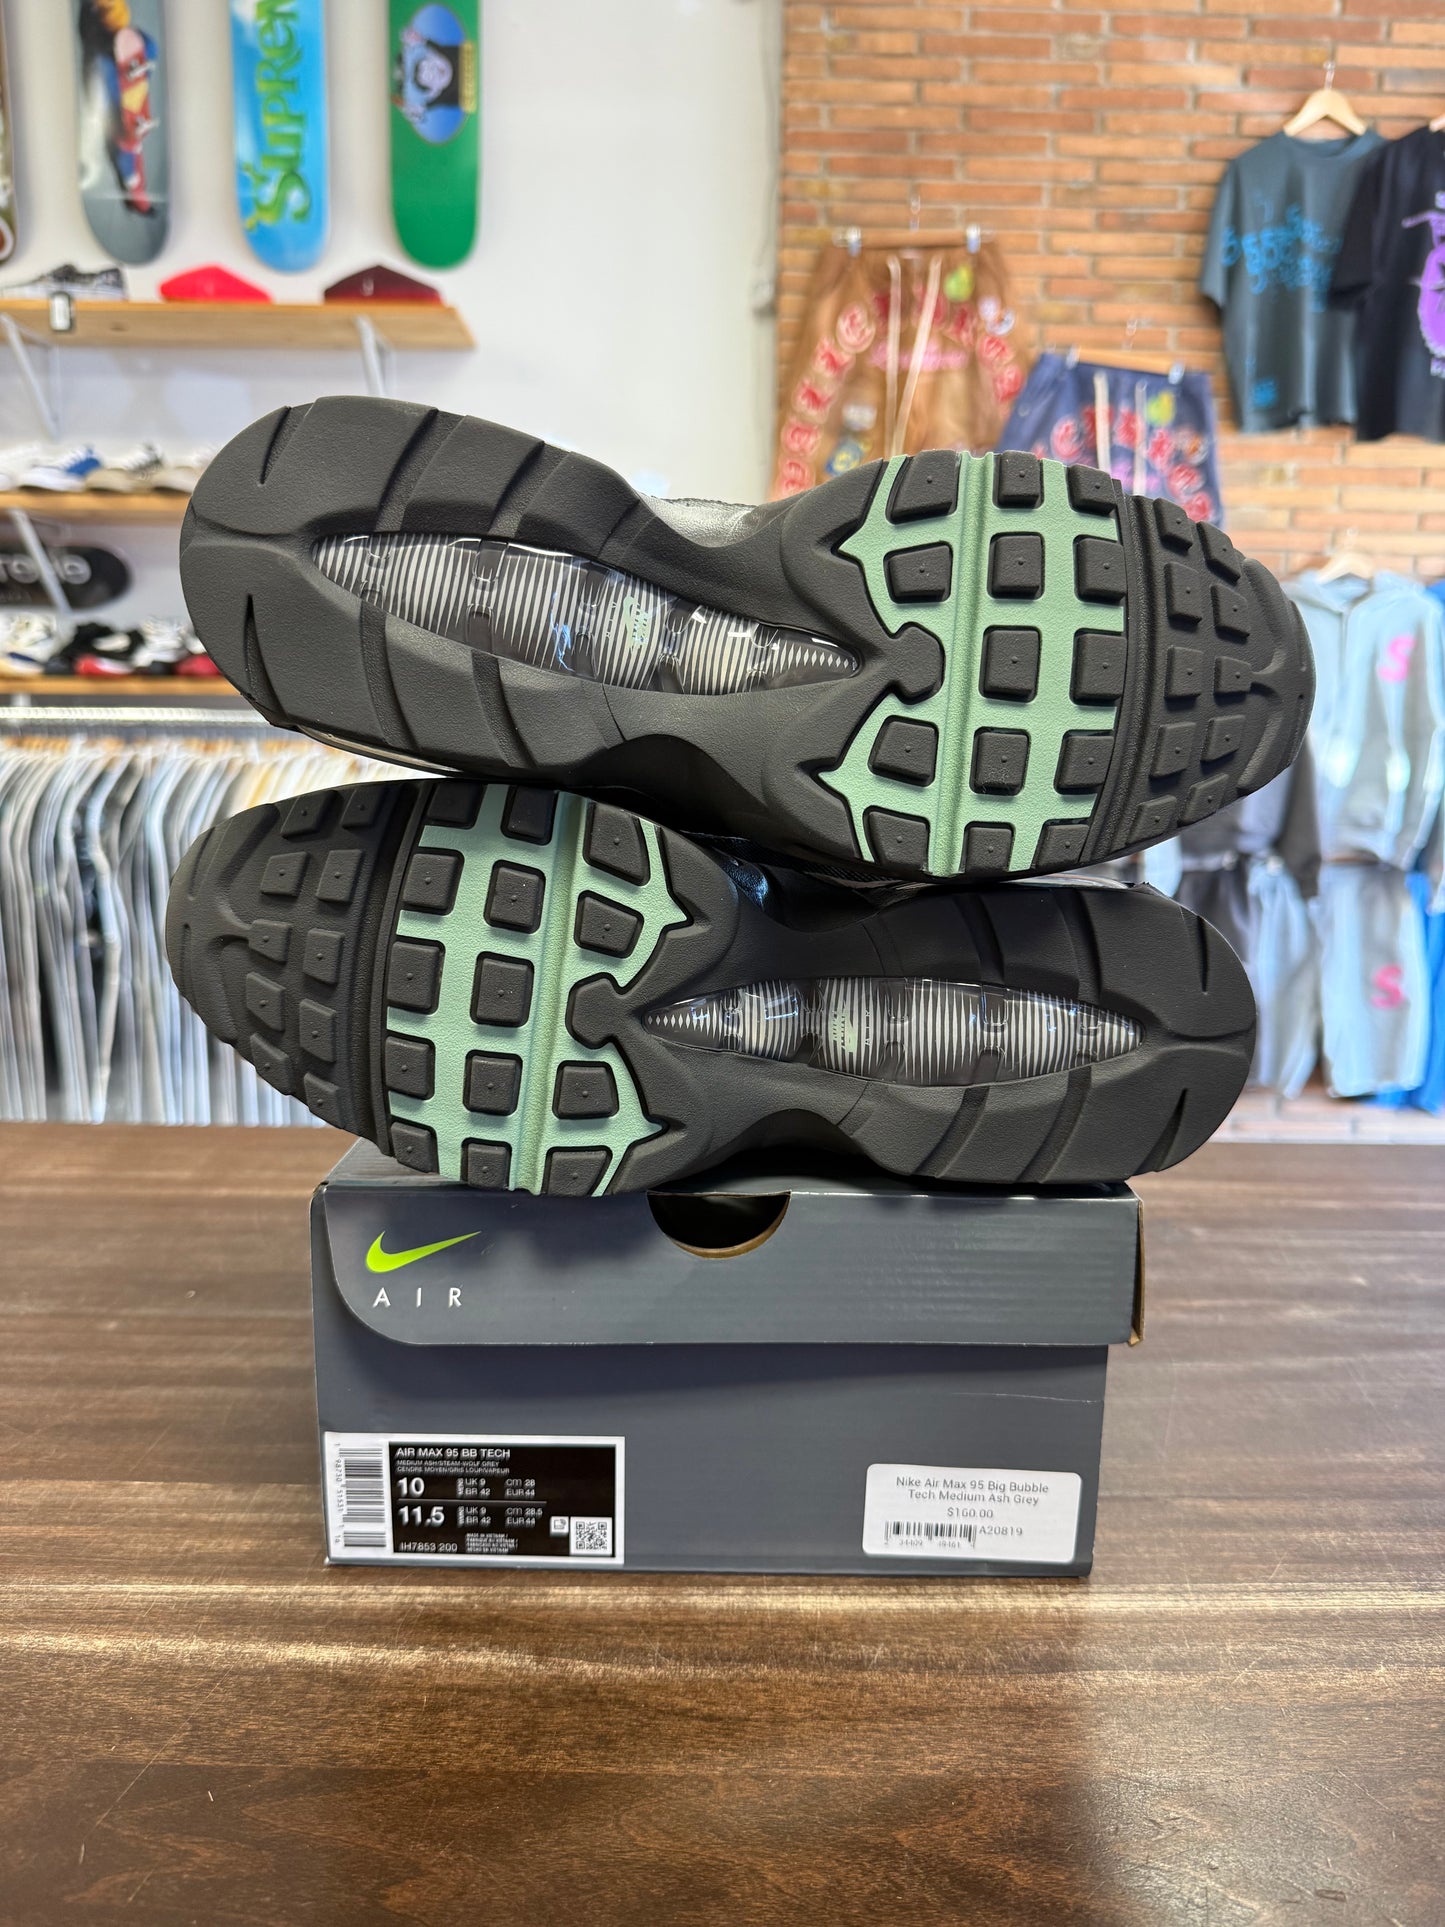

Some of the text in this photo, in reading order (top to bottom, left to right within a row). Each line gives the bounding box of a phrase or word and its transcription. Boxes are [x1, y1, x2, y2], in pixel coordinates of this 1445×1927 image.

[1378, 635, 1415, 682] S
[1372, 964, 1404, 1008] S
[373, 1287, 462, 1307] AIR
[396, 1448, 510, 1458] AIR MAX 95 BB TECH
[397, 1477, 425, 1497] 10
[896, 1476, 1049, 1493] Nike Air Max 95 Big Bubble
[909, 1489, 1039, 1506] Tech Medium Ash Grey
[398, 1506, 445, 1526] 11.5
[506, 1517, 535, 1525] EUR 44
[947, 1507, 994, 1518] $160.00
[979, 1526, 1023, 1536] A20819
[401, 1543, 436, 1551] IH7853
[439, 1543, 458, 1551] 200
